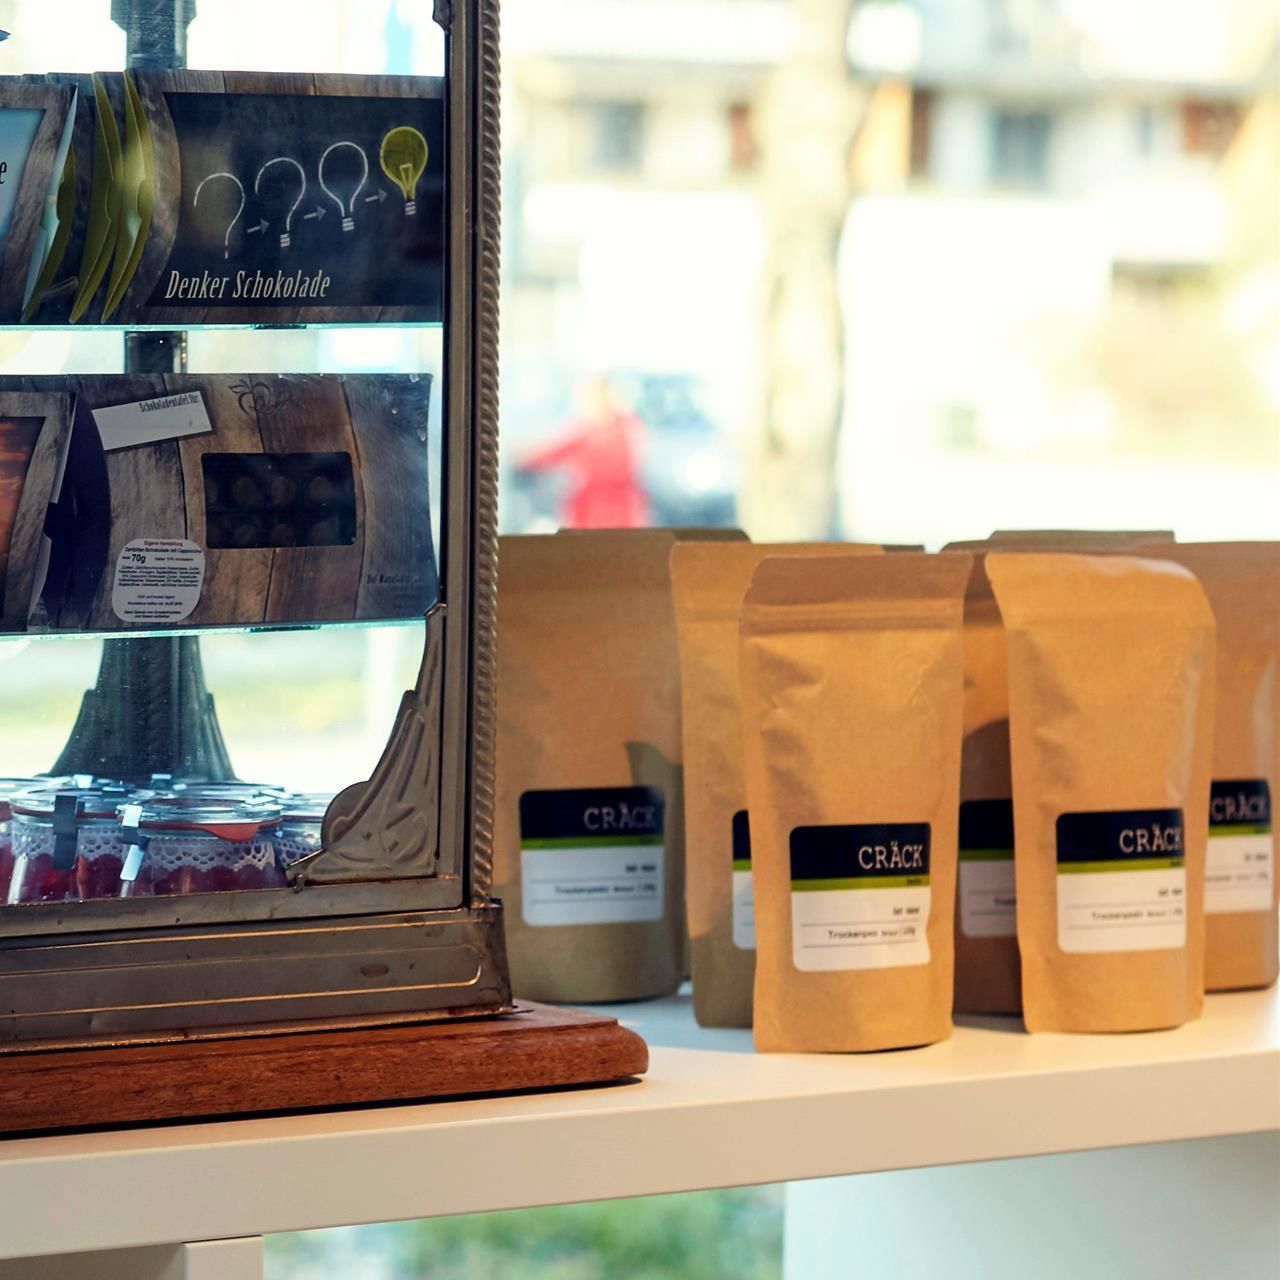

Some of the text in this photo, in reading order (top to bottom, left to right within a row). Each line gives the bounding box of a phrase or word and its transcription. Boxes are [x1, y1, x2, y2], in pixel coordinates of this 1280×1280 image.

[165, 269, 330, 298] Denker Schokolade
[131, 554, 146, 564] 70g
[584, 802, 656, 830] CRÄCK
[859, 841, 923, 869] CRÄCK
